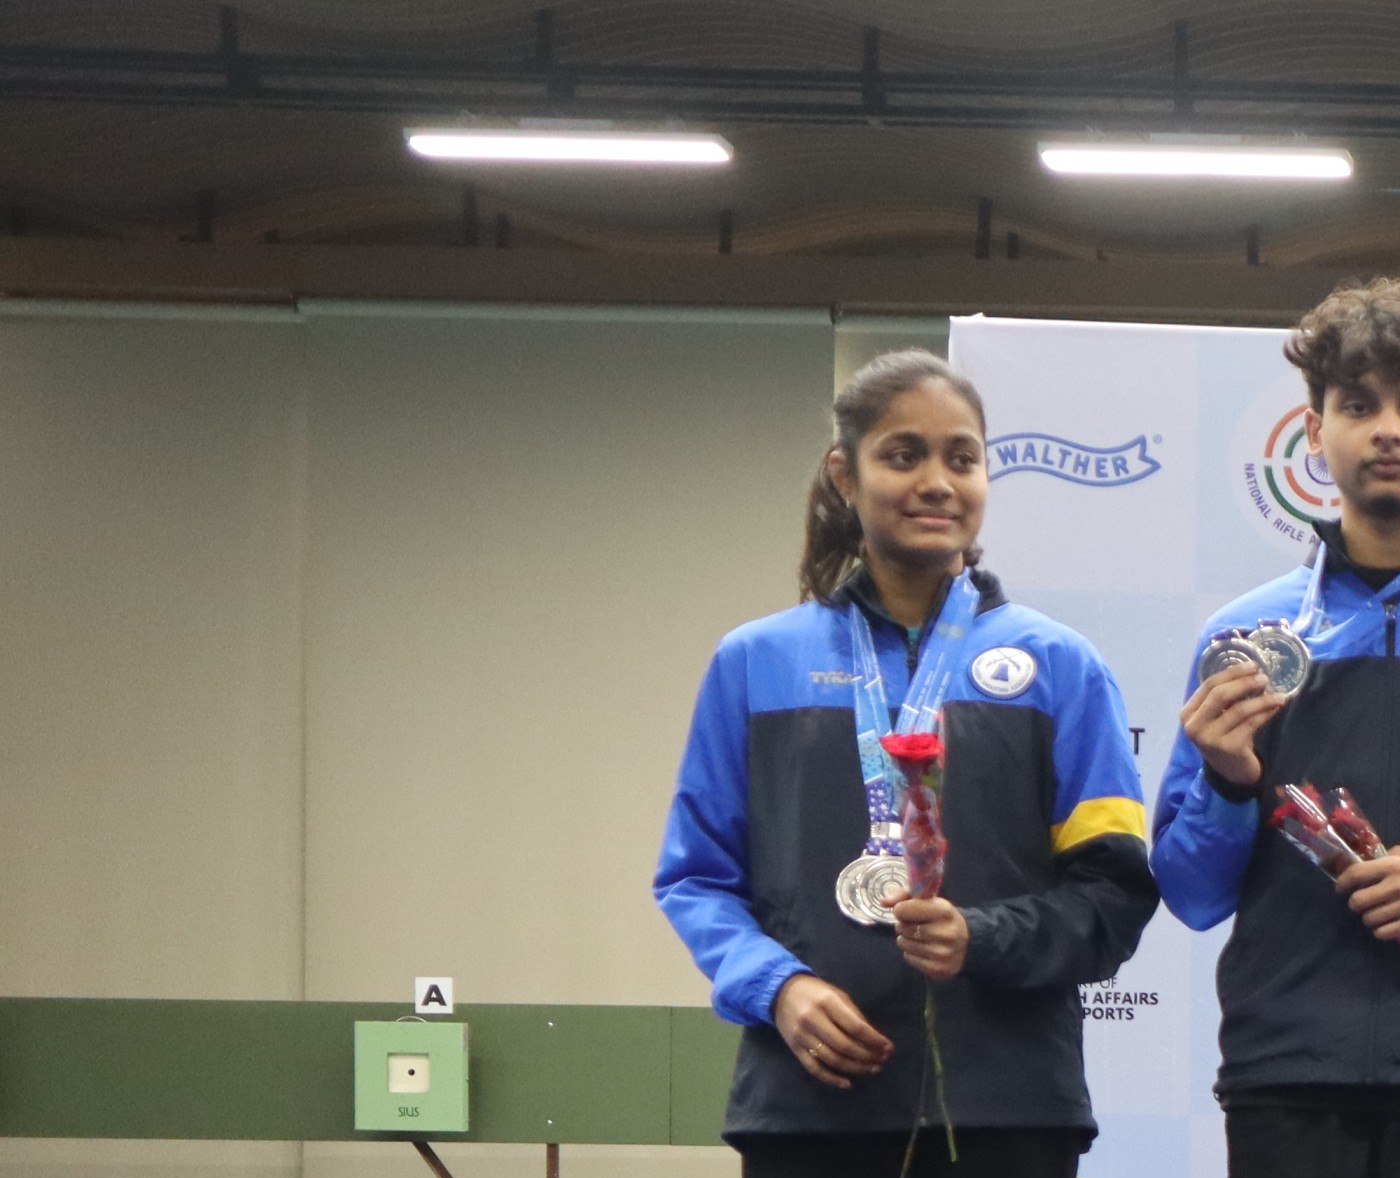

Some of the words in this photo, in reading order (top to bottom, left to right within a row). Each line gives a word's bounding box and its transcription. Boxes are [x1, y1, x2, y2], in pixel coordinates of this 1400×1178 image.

[996, 441, 1130, 478] WALTHER
[1244, 463, 1272, 519] NATIONAL
[1272, 518, 1303, 542] RIFLE
[421, 985, 447, 1006] A
[1093, 992, 1159, 1005] AFFAIRS
[1083, 1007, 1134, 1020] PORTS
[398, 1107, 419, 1117] SIUS
